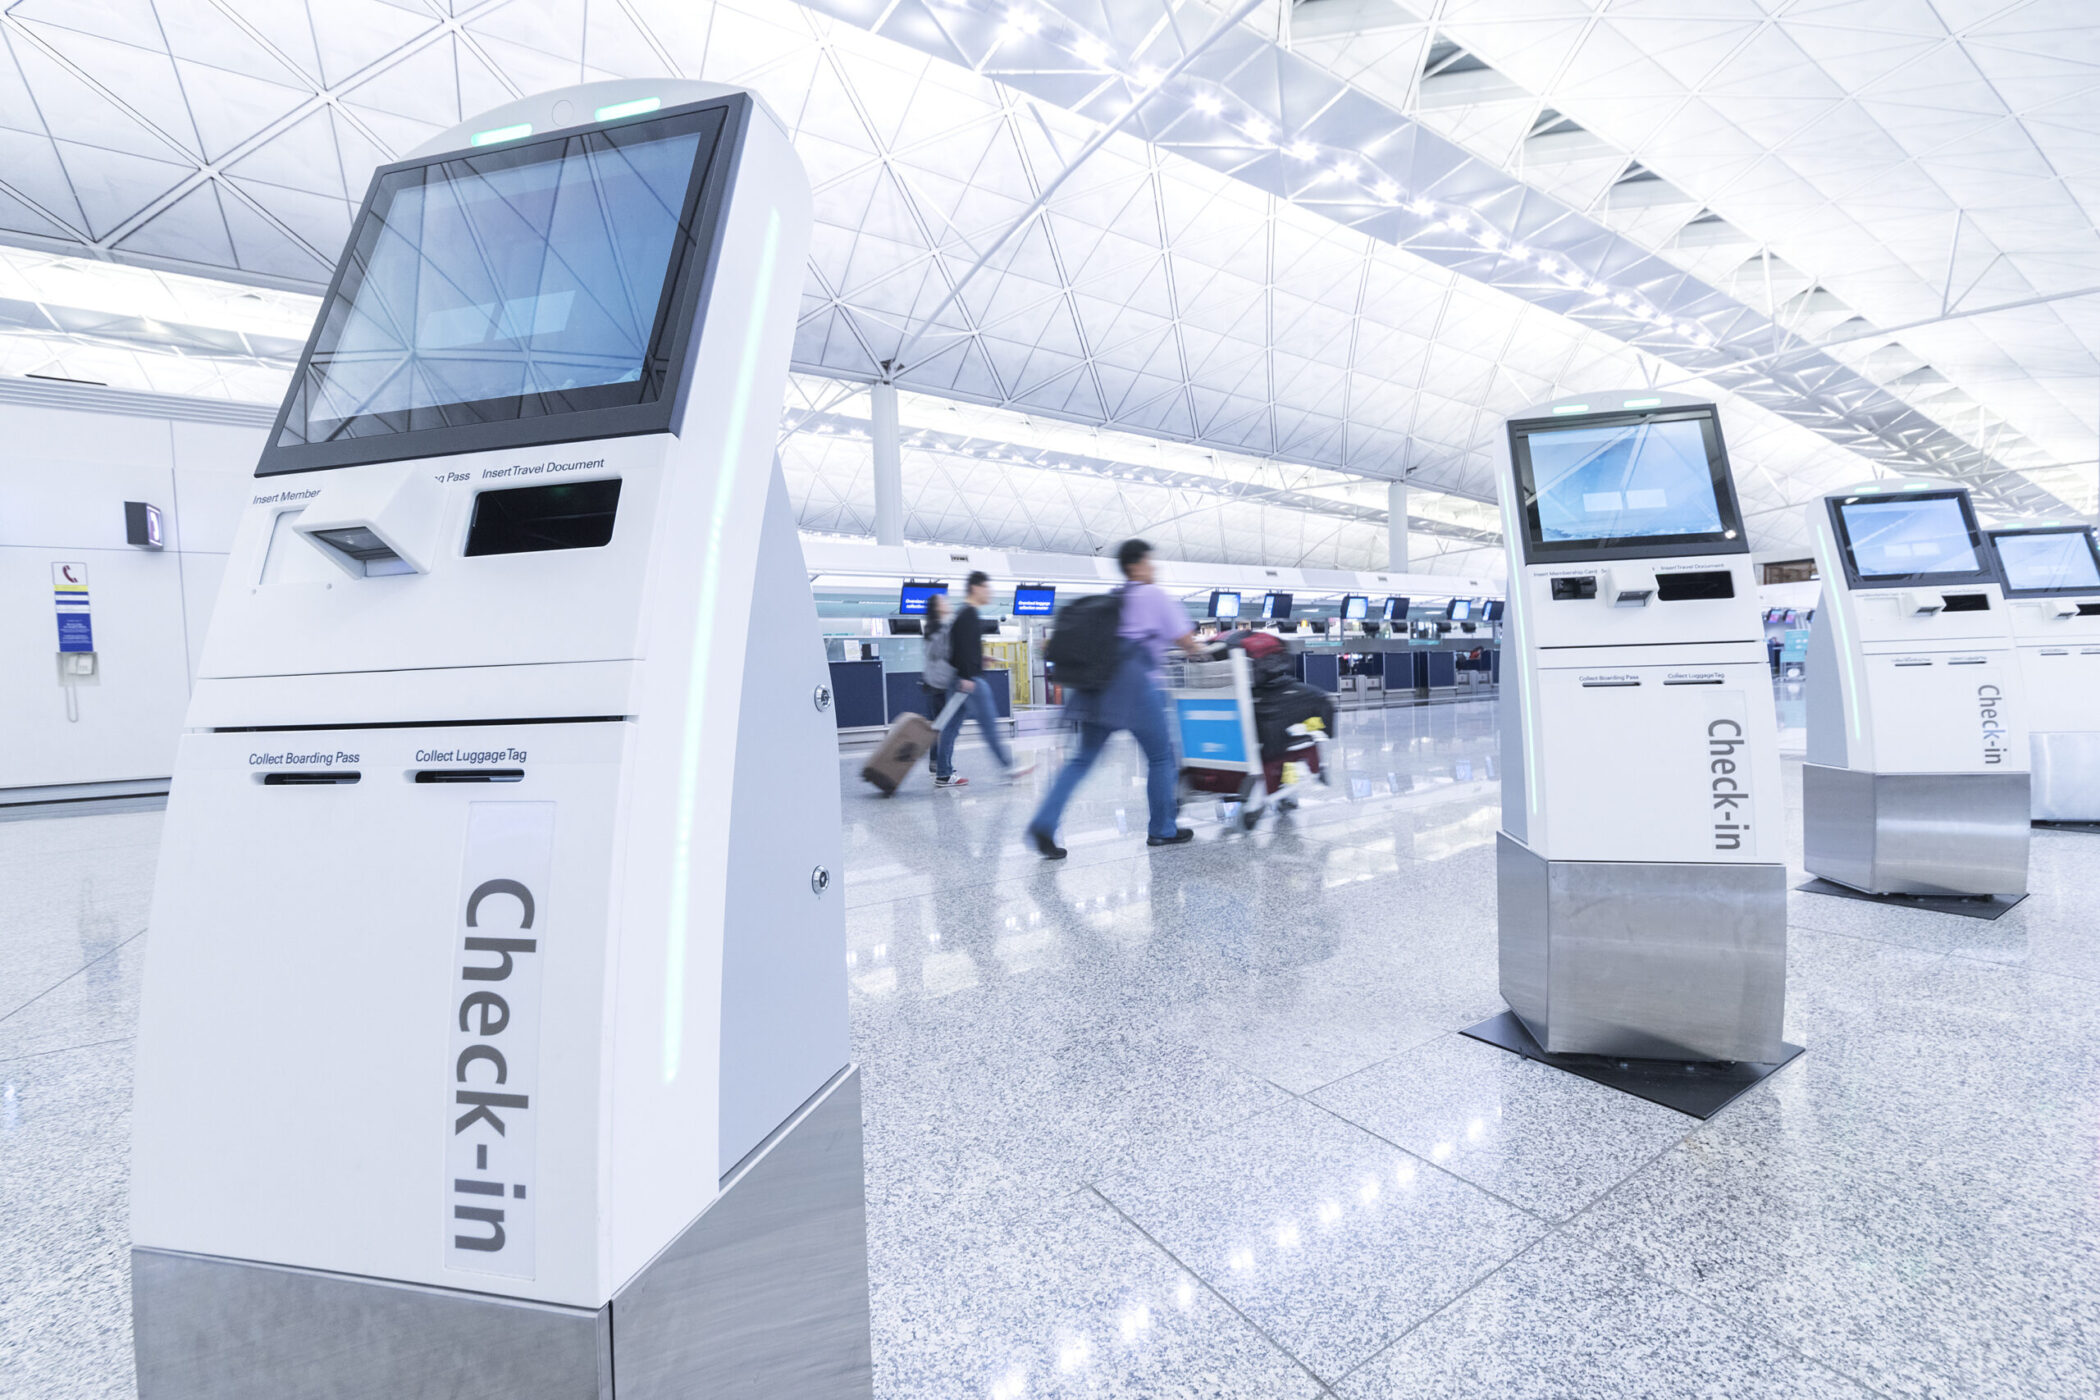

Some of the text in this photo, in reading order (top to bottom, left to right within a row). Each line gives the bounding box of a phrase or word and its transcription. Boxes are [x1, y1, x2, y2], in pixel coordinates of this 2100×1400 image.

[446, 471, 471, 482] Pass
[482, 458, 605, 479] Insert Travel Document
[252, 488, 322, 505] Insert Member
[1978, 685, 2007, 764] Check-in
[249, 751, 360, 766] Collect Boarding Pass
[415, 748, 527, 764] Collect Luggage Tag
[1708, 719, 1750, 850] Check-in
[454, 878, 537, 1252] Check-in
